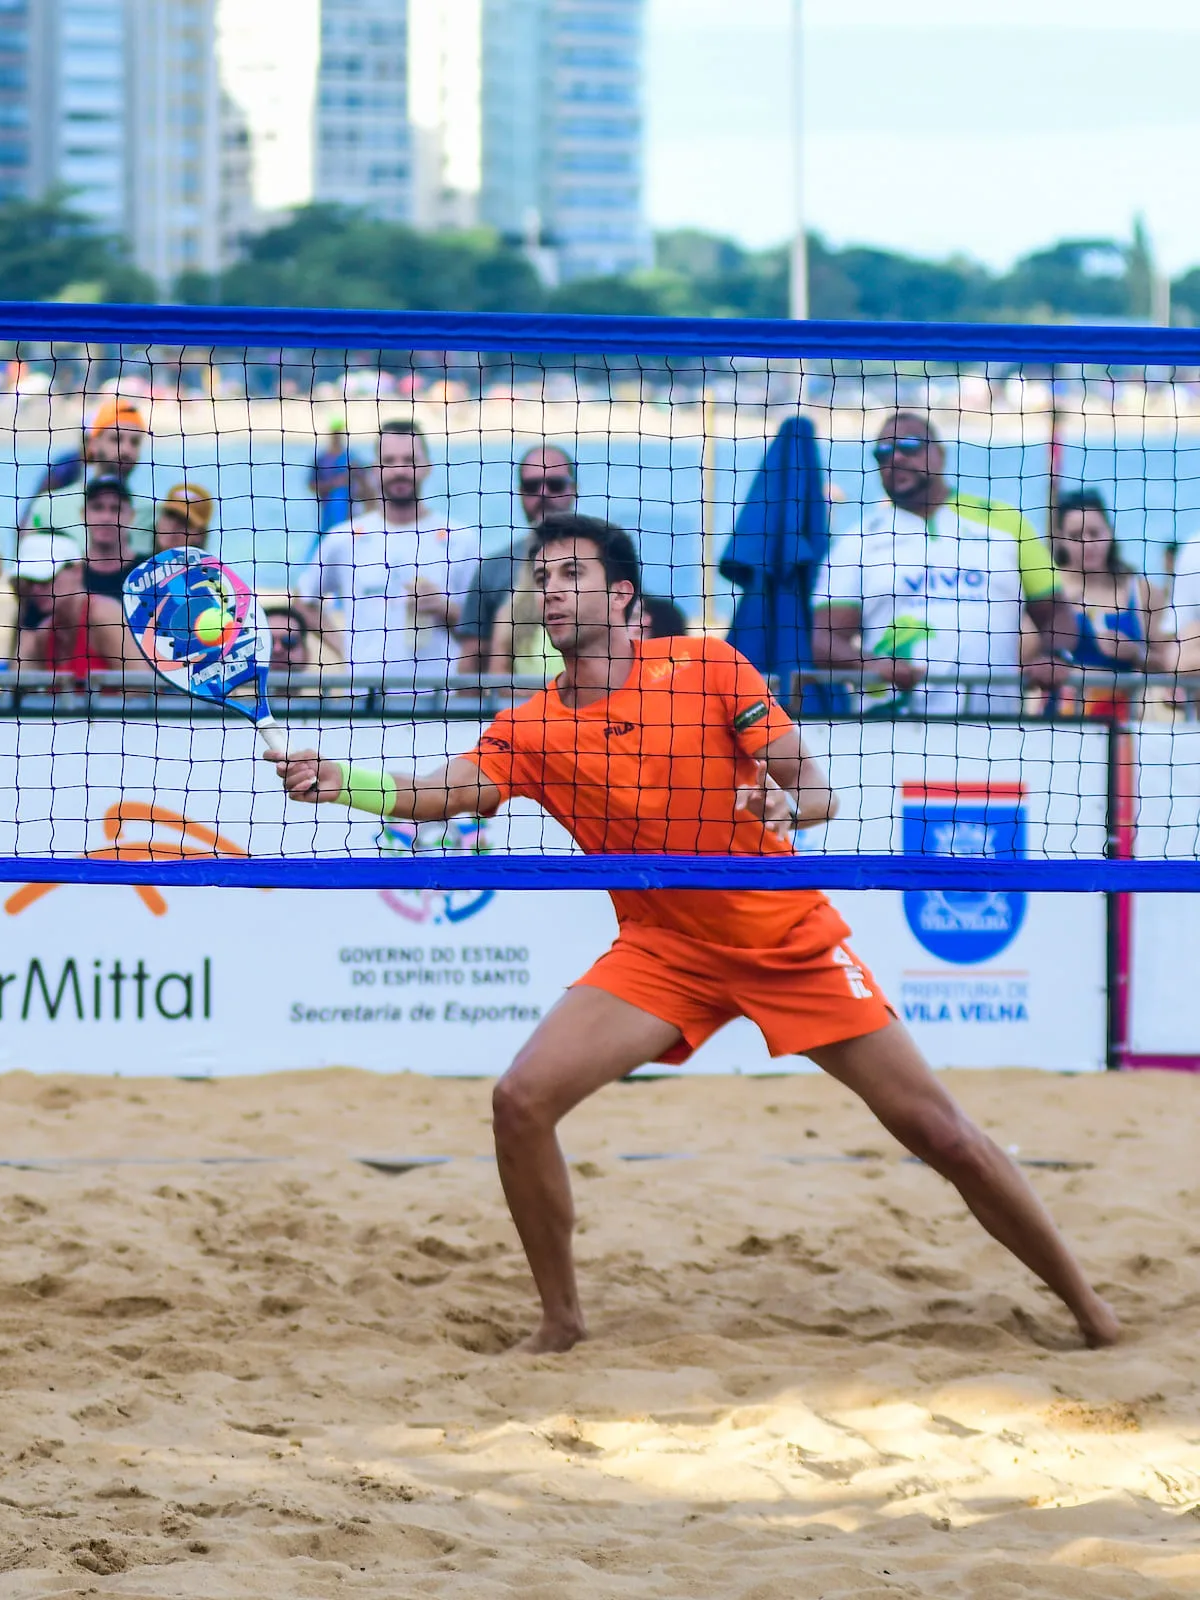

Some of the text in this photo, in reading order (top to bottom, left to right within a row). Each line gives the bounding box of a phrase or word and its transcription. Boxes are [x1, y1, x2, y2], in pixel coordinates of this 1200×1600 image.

[603, 722, 635, 738] FILA
[339, 947, 528, 963] GOVERNO DO ESTADO
[352, 966, 529, 985] DO ESPÍRITO SANTO
[902, 982, 1028, 998] PREFEITURA DE
[291, 1002, 541, 1027] Secretaria de Esportes
[904, 1003, 1029, 1022] VILA VELHA
